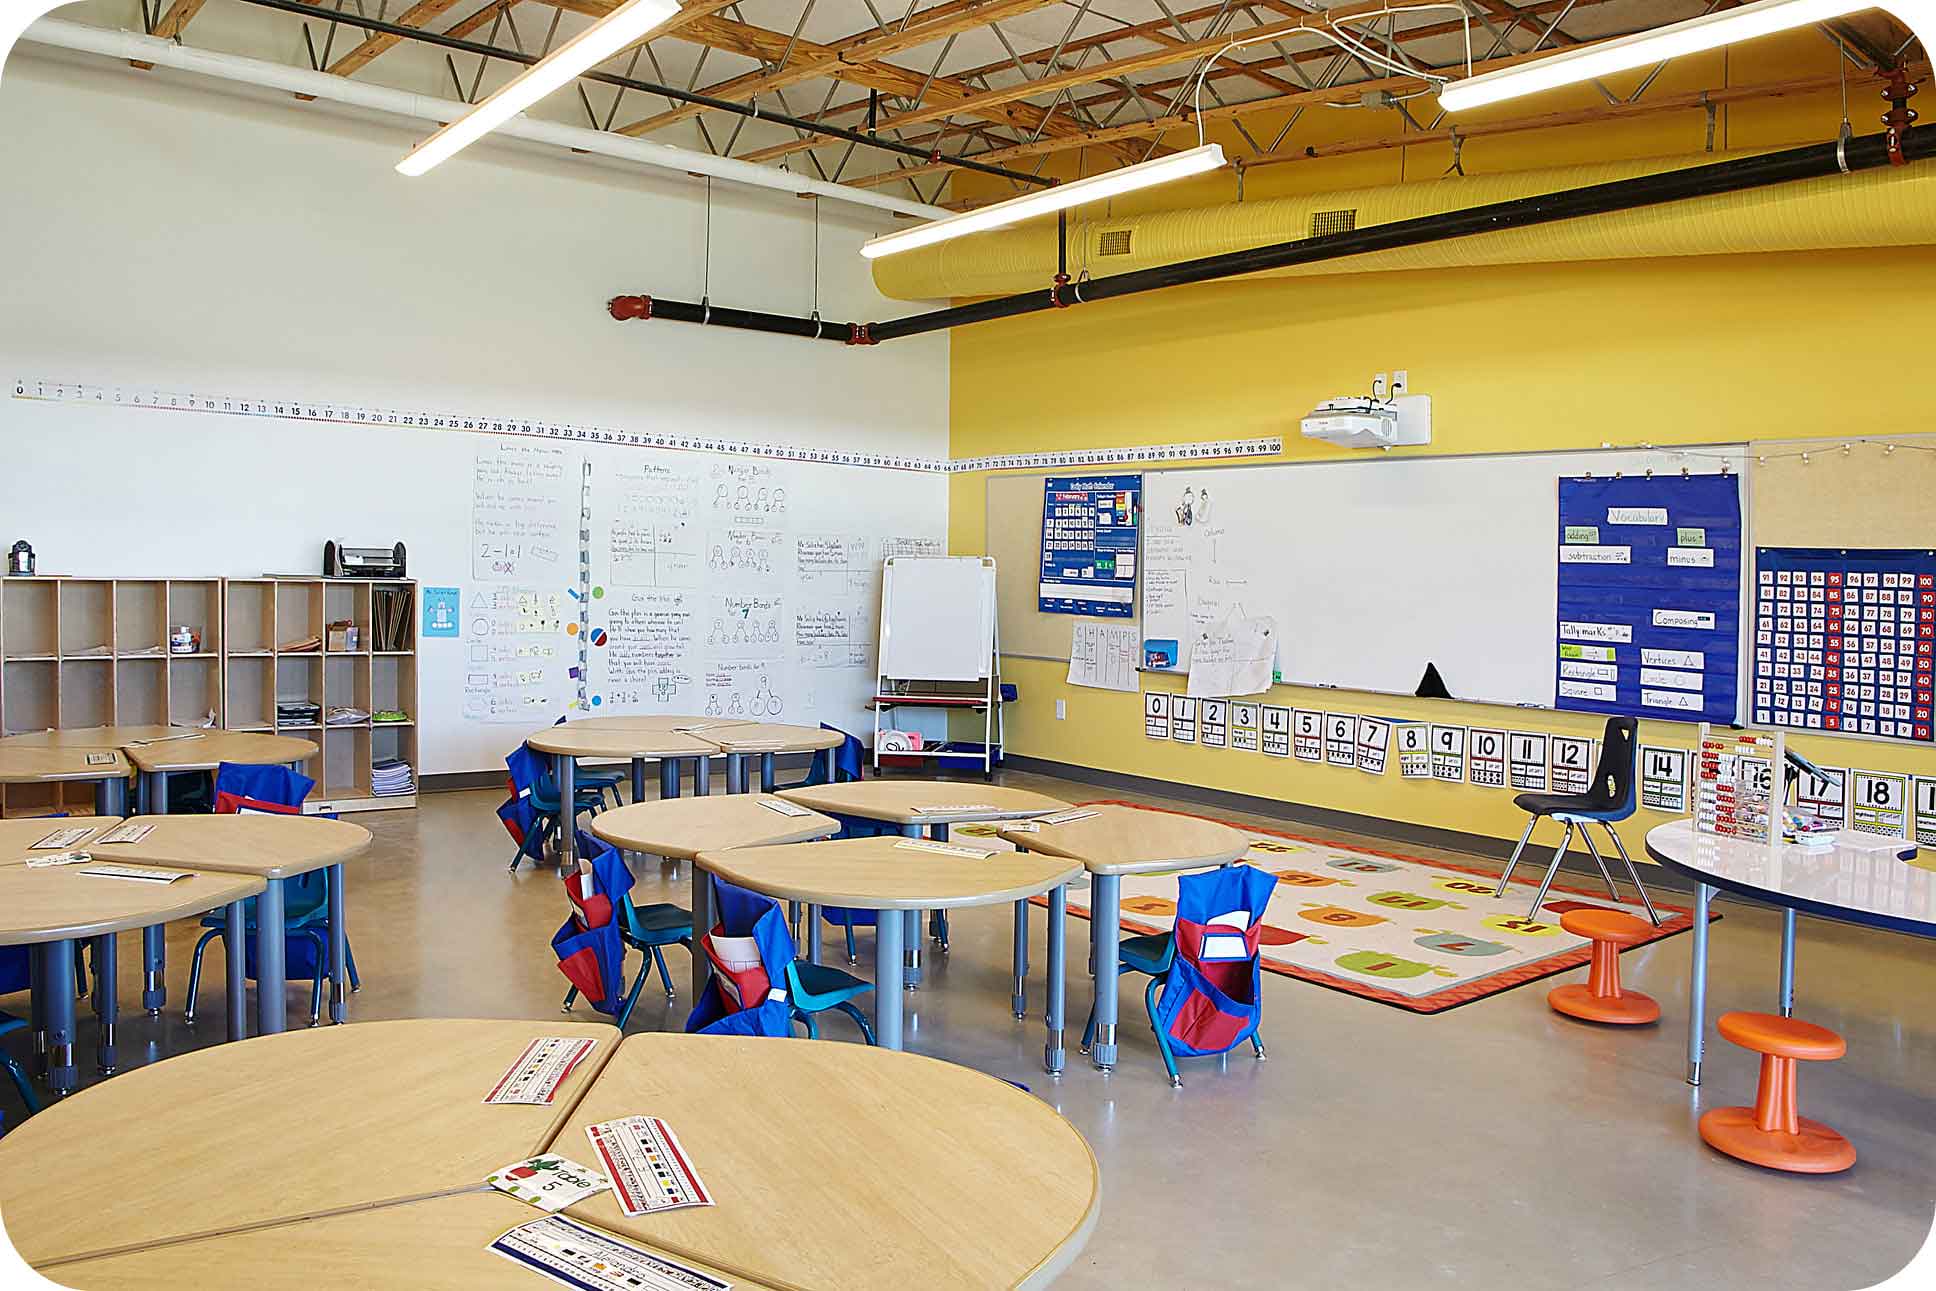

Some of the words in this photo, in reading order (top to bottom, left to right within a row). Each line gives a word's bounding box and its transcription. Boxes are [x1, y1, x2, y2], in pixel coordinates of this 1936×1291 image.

[17, 386, 24, 395] 0
[205, 400, 214, 409] 10
[240, 403, 249, 411] 12
[257, 404, 266, 413] 13
[274, 405, 283, 414] 14
[291, 406, 300, 415] 15
[308, 408, 316, 417] 16
[325, 409, 333, 418] 17
[357, 412, 365, 420] 19
[371, 413, 382, 422] 20
[388, 414, 396, 423] 21
[403, 416, 413, 424] 22
[418, 417, 428, 425] 23
[434, 418, 443, 427] 24
[448, 419, 458, 428] 25
[463, 420, 473, 429] 26
[478, 422, 487, 430] 27
[728, 444, 736, 452] 46
[740, 445, 748, 453] 47
[752, 446, 760, 454] 48
[764, 447, 772, 455] 49
[776, 448, 783, 456] 50
[1168, 449, 1175, 457] 91
[1178, 449, 1186, 457] 92
[1189, 448, 1197, 456] 93
[1201, 447, 1208, 455] 94
[1212, 447, 1220, 455] 95
[1223, 446, 1231, 454] 96
[1235, 445, 1242, 453] 97
[1246, 445, 1254, 453] 98
[1257, 444, 1266, 452] 99
[1269, 443, 1280, 451] 100
[1680, 533, 1697, 543] plus
[1568, 552, 1611, 561] subtraction
[1670, 555, 1696, 564] minus
[1902, 577, 1912, 585] 99
[1919, 578, 1932, 586] 100
[742, 608, 750, 619] 7
[1655, 612, 1698, 627] Composing
[1780, 605, 1788, 613] 72
[1922, 611, 1932, 619] 80
[1561, 624, 1580, 638] Tally
[1777, 636, 1786, 644] 52
[1830, 639, 1839, 647] 55
[1846, 640, 1856, 648] 56
[1866, 641, 1874, 649] 57
[1919, 644, 1930, 652] 60
[1152, 697, 1161, 714] 0
[1644, 693, 1673, 705] Triangle
[1181, 700, 1186, 717] 1
[1208, 704, 1218, 721] 2
[1240, 708, 1250, 725] 3
[1270, 712, 1280, 729] 4
[1302, 715, 1312, 733] 5
[1335, 720, 1346, 737] 6
[1367, 725, 1378, 742] 7
[1406, 730, 1417, 748] 8
[1441, 731, 1453, 750] 9
[1478, 735, 1495, 755] 10
[1522, 739, 1532, 759] 11
[1561, 743, 1579, 764] 12
[1652, 754, 1672, 777] 14
[1866, 779, 1890, 805] 18
[542, 1181, 563, 1191] 5
[551, 1169, 592, 1189] Table
